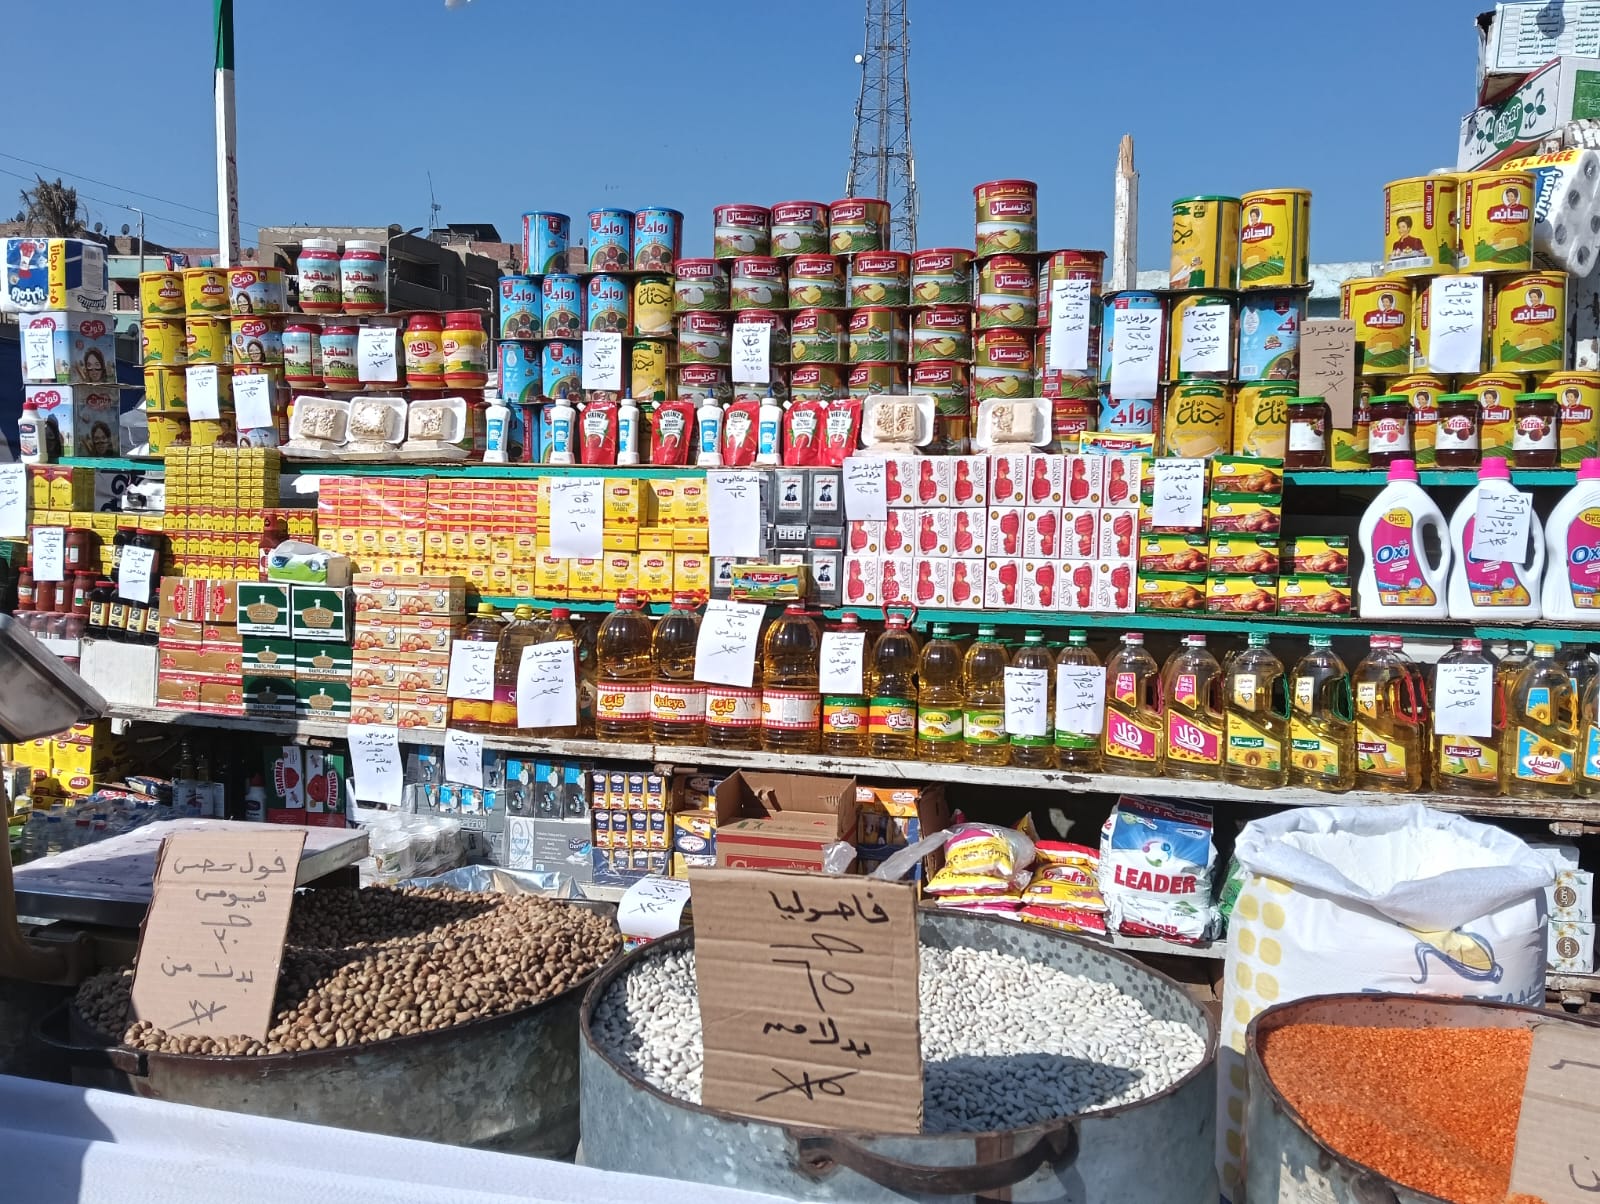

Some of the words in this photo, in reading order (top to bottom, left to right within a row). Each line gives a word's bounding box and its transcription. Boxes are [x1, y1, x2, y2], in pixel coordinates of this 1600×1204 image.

[1537, 151, 1575, 165] FREE
[992, 200, 1031, 214] كريستال
[728, 211, 764, 224] كريستال
[776, 208, 811, 223] كريستال
[797, 262, 833, 275] كريستال
[859, 259, 896, 272] كريستال
[916, 257, 951, 270] كريستال
[678, 265, 711, 278] Crystal
[996, 274, 1035, 288] كريستال
[927, 312, 964, 325] كريستال
[991, 348, 1030, 361] كريستال
[682, 369, 716, 382] كريستال
[915, 369, 951, 382] كريستال
[587, 412, 606, 420] HEINZ
[663, 411, 681, 420] HEINZ
[730, 412, 747, 420] HEINZ
[795, 410, 813, 418] HEINZ
[830, 410, 849, 418] HEINZ
[1376, 421, 1400, 432] vitrac
[1447, 418, 1470, 429] vitrac
[1520, 418, 1544, 429] vitrac
[1388, 514, 1406, 523] 6KG
[654, 694, 686, 710] Qaleya
[1231, 737, 1263, 747] كريستال
[1357, 743, 1386, 752] كريستال
[1446, 747, 1480, 757] كريستال
[275, 759, 285, 797] SHAMIA
[327, 770, 336, 808] SHAMIA
[240, 848, 286, 881] فول
[1114, 864, 1198, 895] LEADER
[768, 890, 890, 924] فاصوليا
